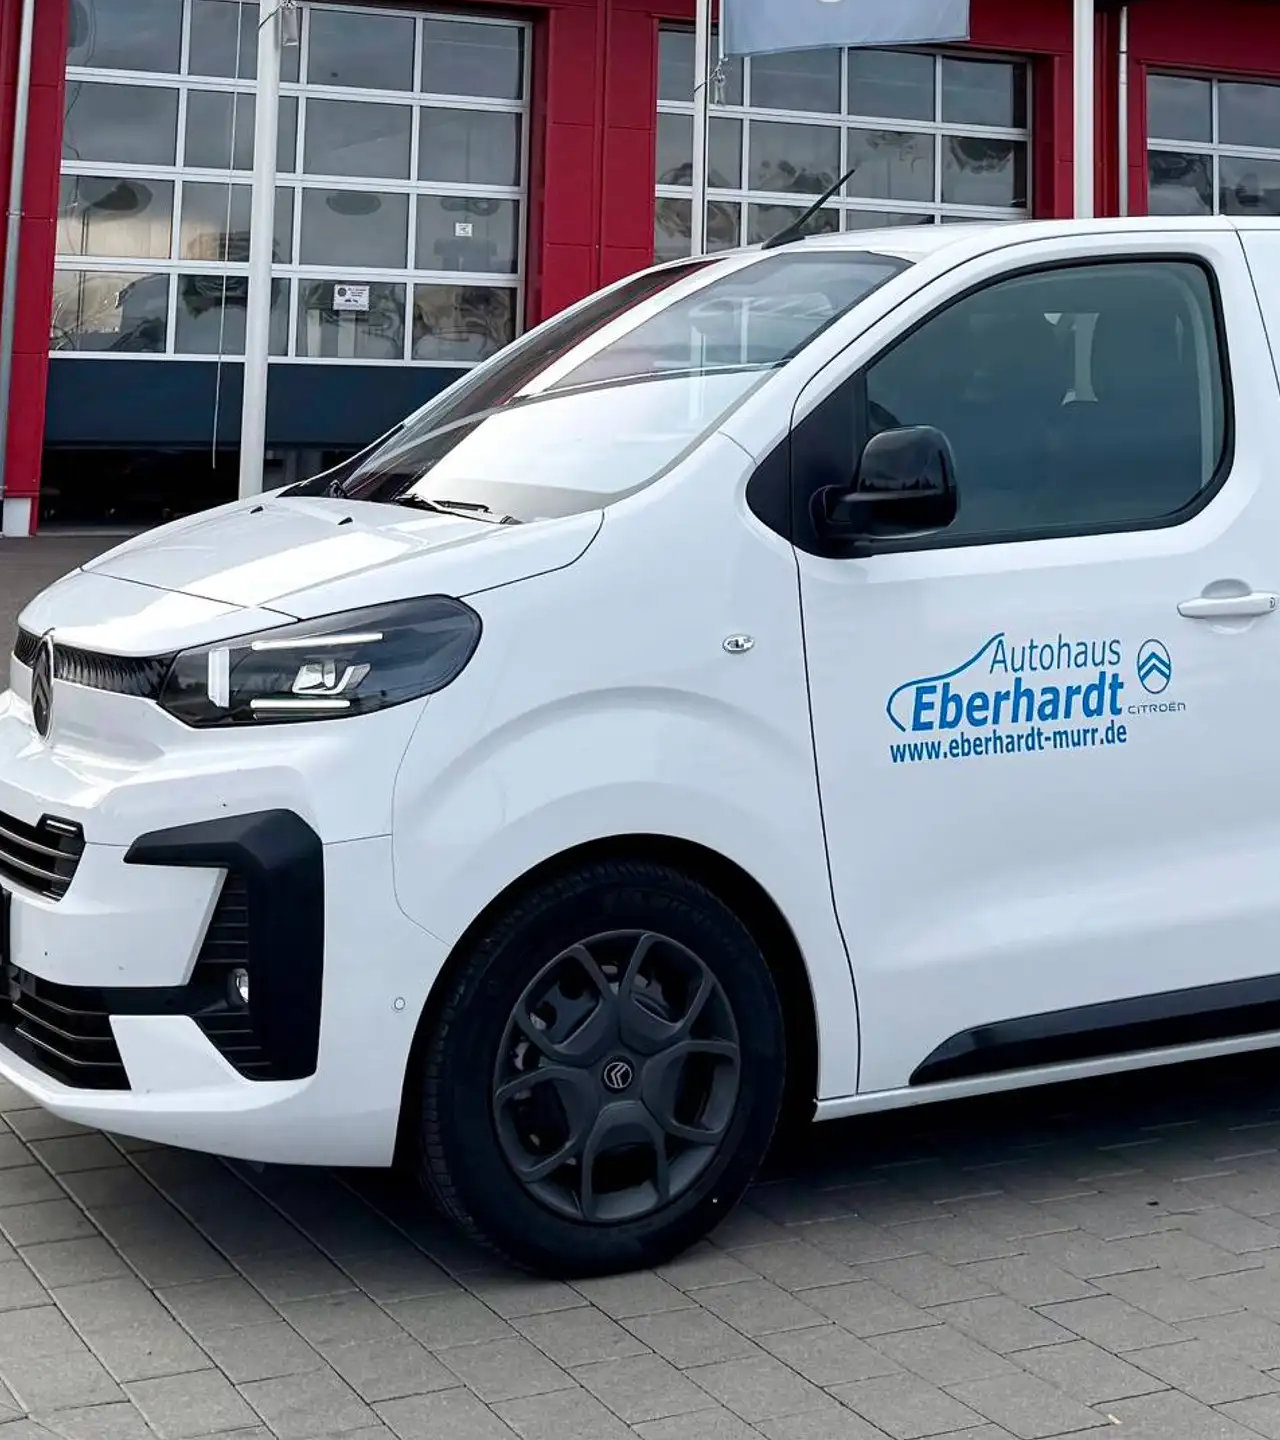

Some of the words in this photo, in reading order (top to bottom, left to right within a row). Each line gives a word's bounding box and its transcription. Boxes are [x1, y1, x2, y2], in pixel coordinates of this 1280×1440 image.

[989, 633, 1121, 675] Autohaus
[911, 670, 1125, 732] Eberhardt
[1127, 701, 1187, 715] CITROËN
[890, 720, 1128, 763] www.eberhardt-murr.de
